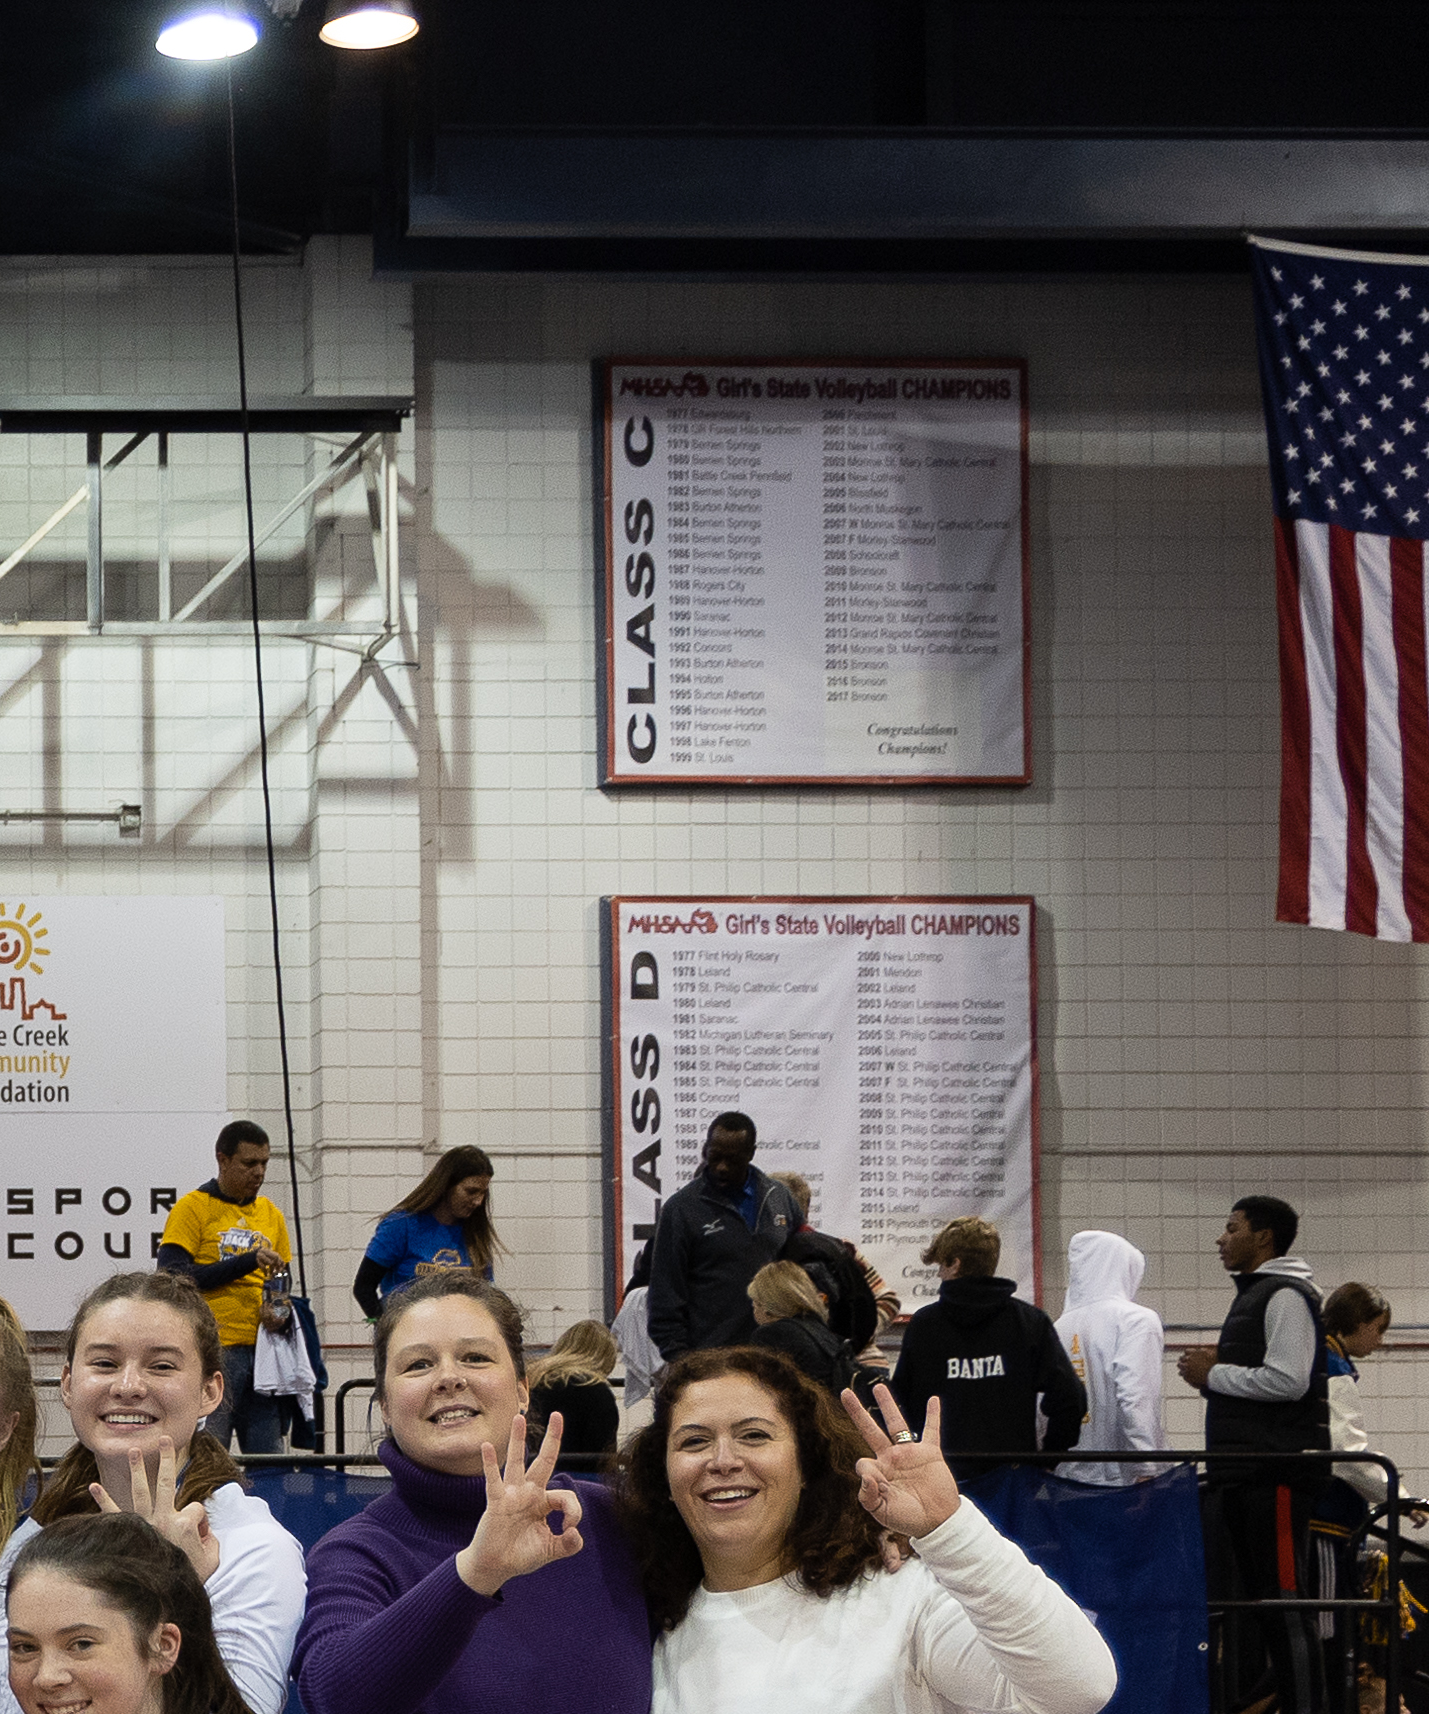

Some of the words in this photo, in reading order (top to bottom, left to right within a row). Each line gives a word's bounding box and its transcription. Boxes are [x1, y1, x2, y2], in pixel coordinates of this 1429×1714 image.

[717, 378, 762, 399] Girl's
[767, 378, 811, 399] State
[815, 378, 897, 403] Volleyball
[902, 377, 1011, 400] CHAMPIONS
[624, 415, 655, 467] C
[624, 498, 657, 764] CLASS
[726, 913, 771, 935] Girl's
[775, 913, 819, 935] State
[824, 913, 906, 939] Volleyball
[911, 913, 1020, 936] CHAMPIONS
[630, 951, 660, 1000] D
[12, 1024, 70, 1047] Creek
[630, 1034, 663, 1270] LASS
[6, 1186, 177, 1216] SPOR
[6, 1231, 162, 1260] COU
[947, 1354, 1005, 1379] BANTA
